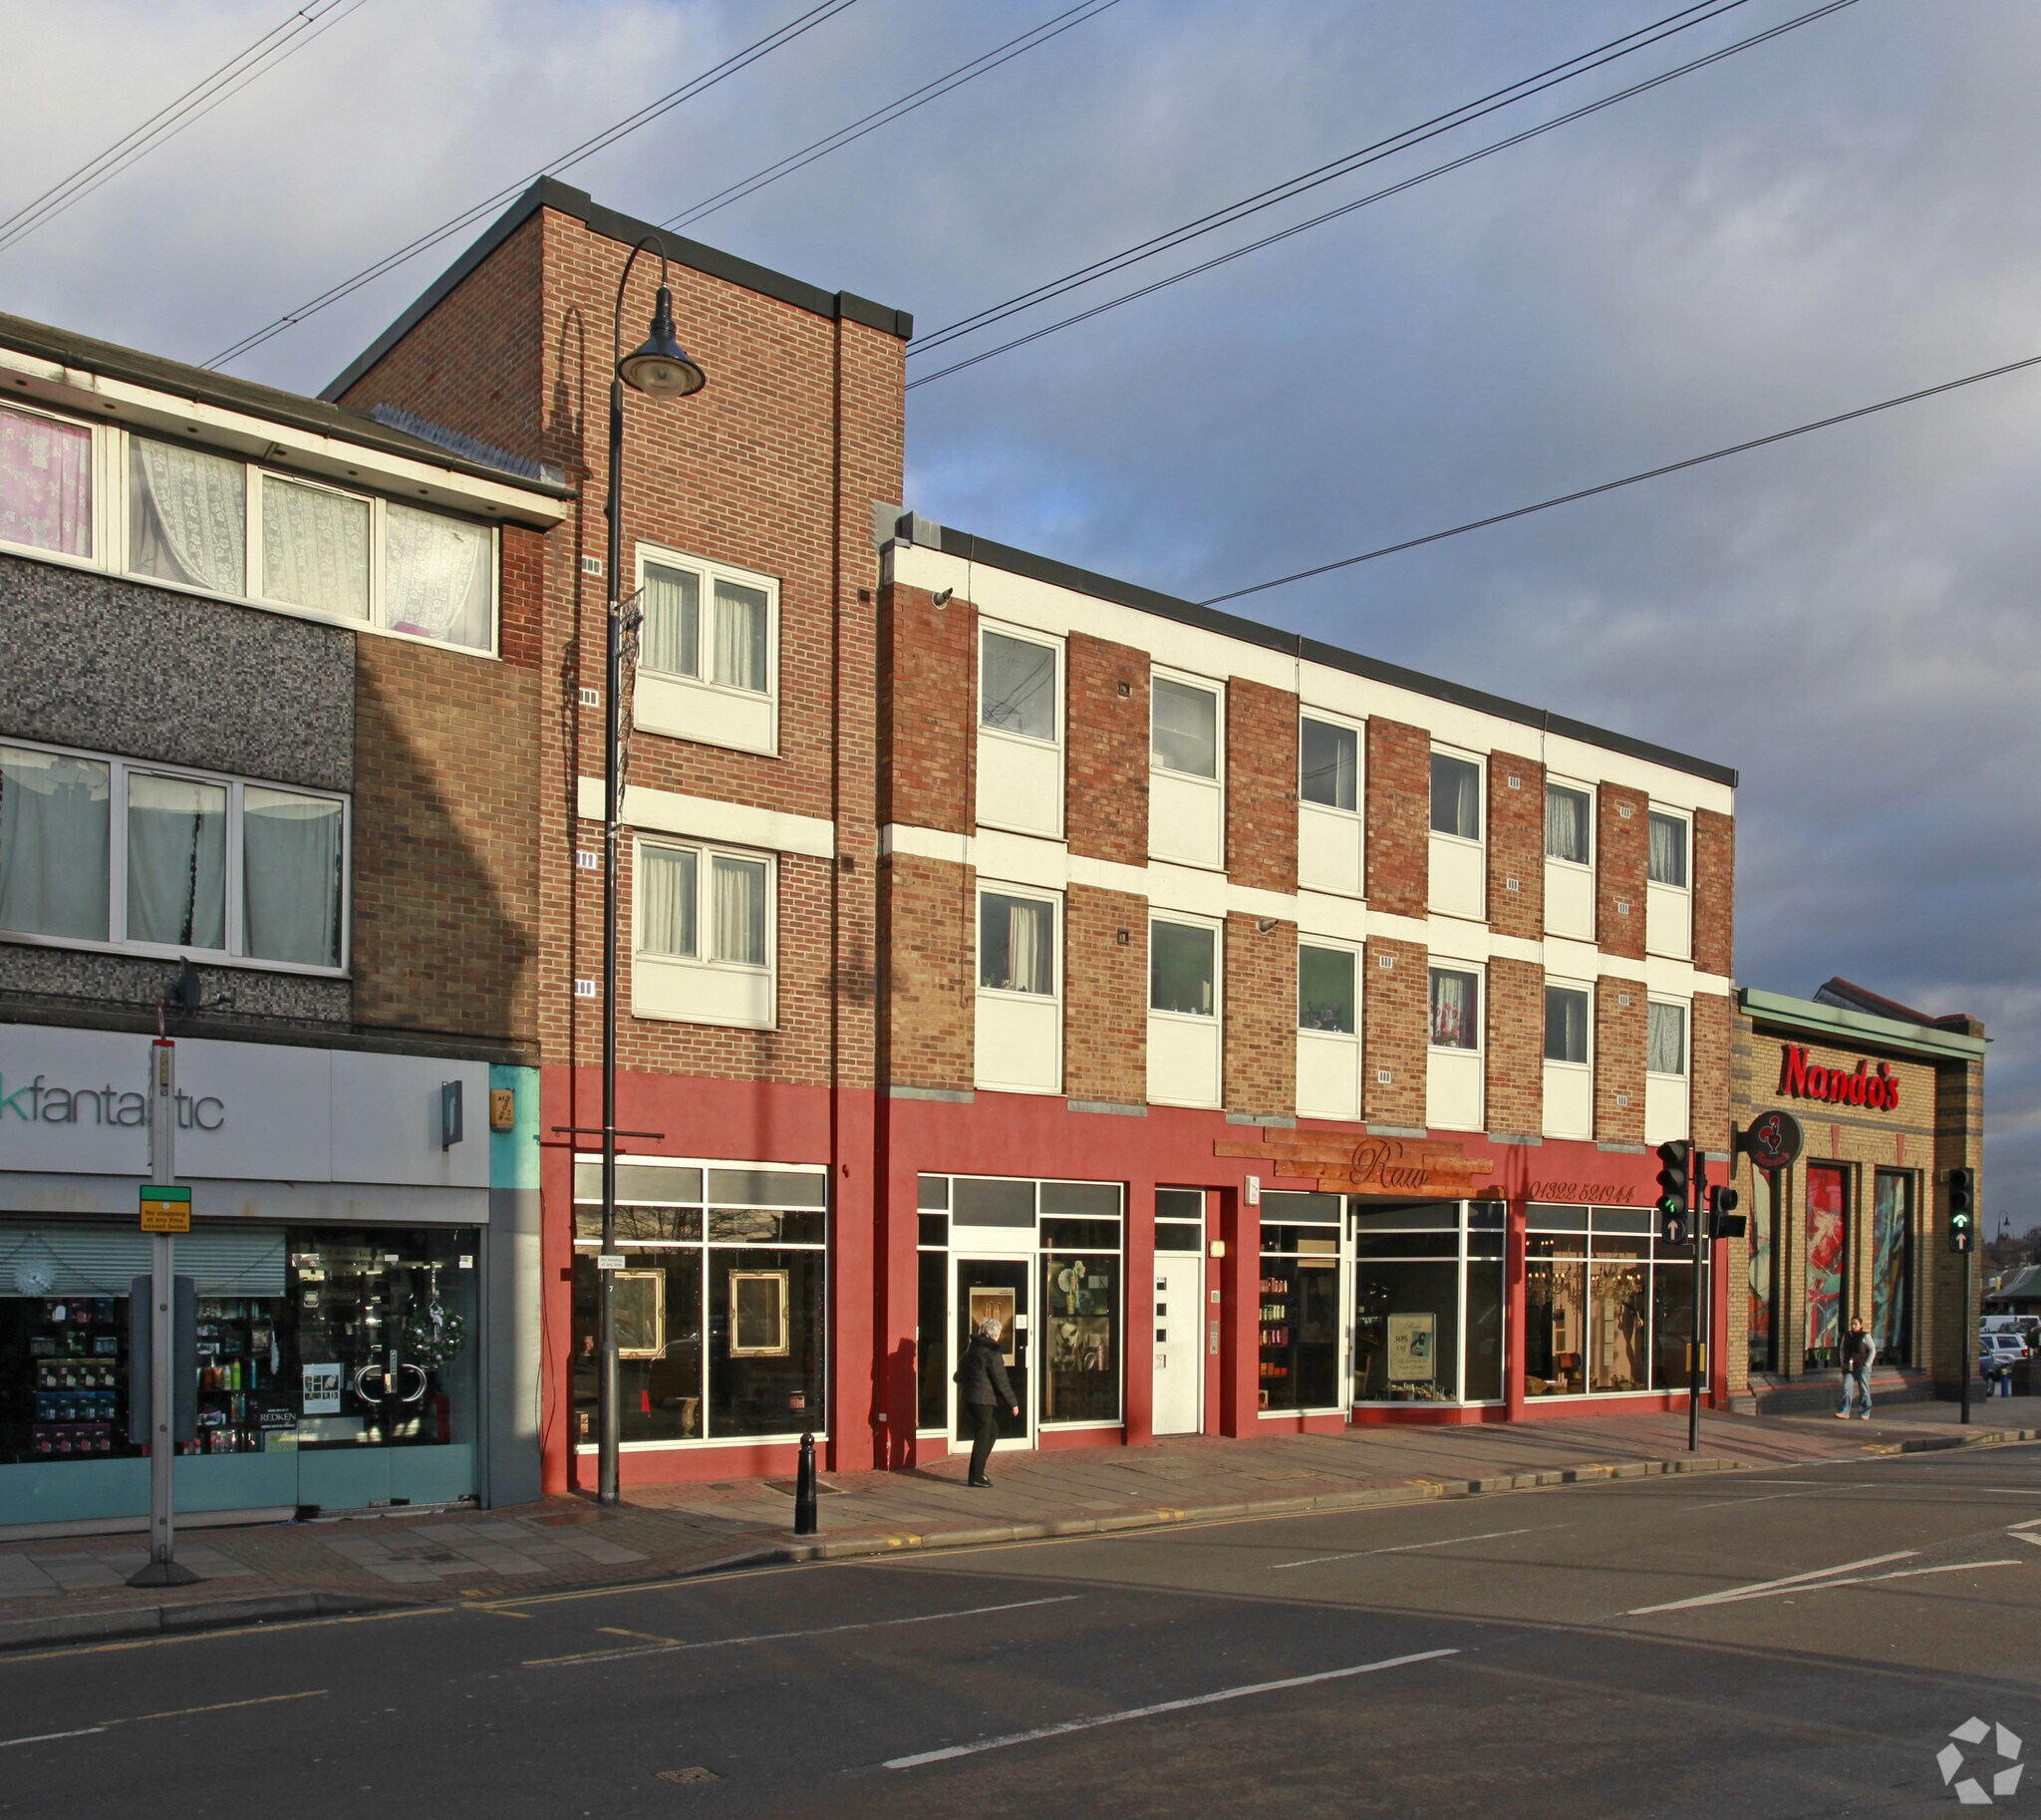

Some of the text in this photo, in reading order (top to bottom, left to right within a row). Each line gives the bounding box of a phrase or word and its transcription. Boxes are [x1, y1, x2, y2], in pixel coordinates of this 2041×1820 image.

[0, 1071, 225, 1130] kfantatic
[1780, 1044, 1899, 1111] Nando's
[1349, 1138, 1429, 1189] Raw
[1529, 1180, 1636, 1203] 01322 521944
[259, 1412, 297, 1421] REDKEN
